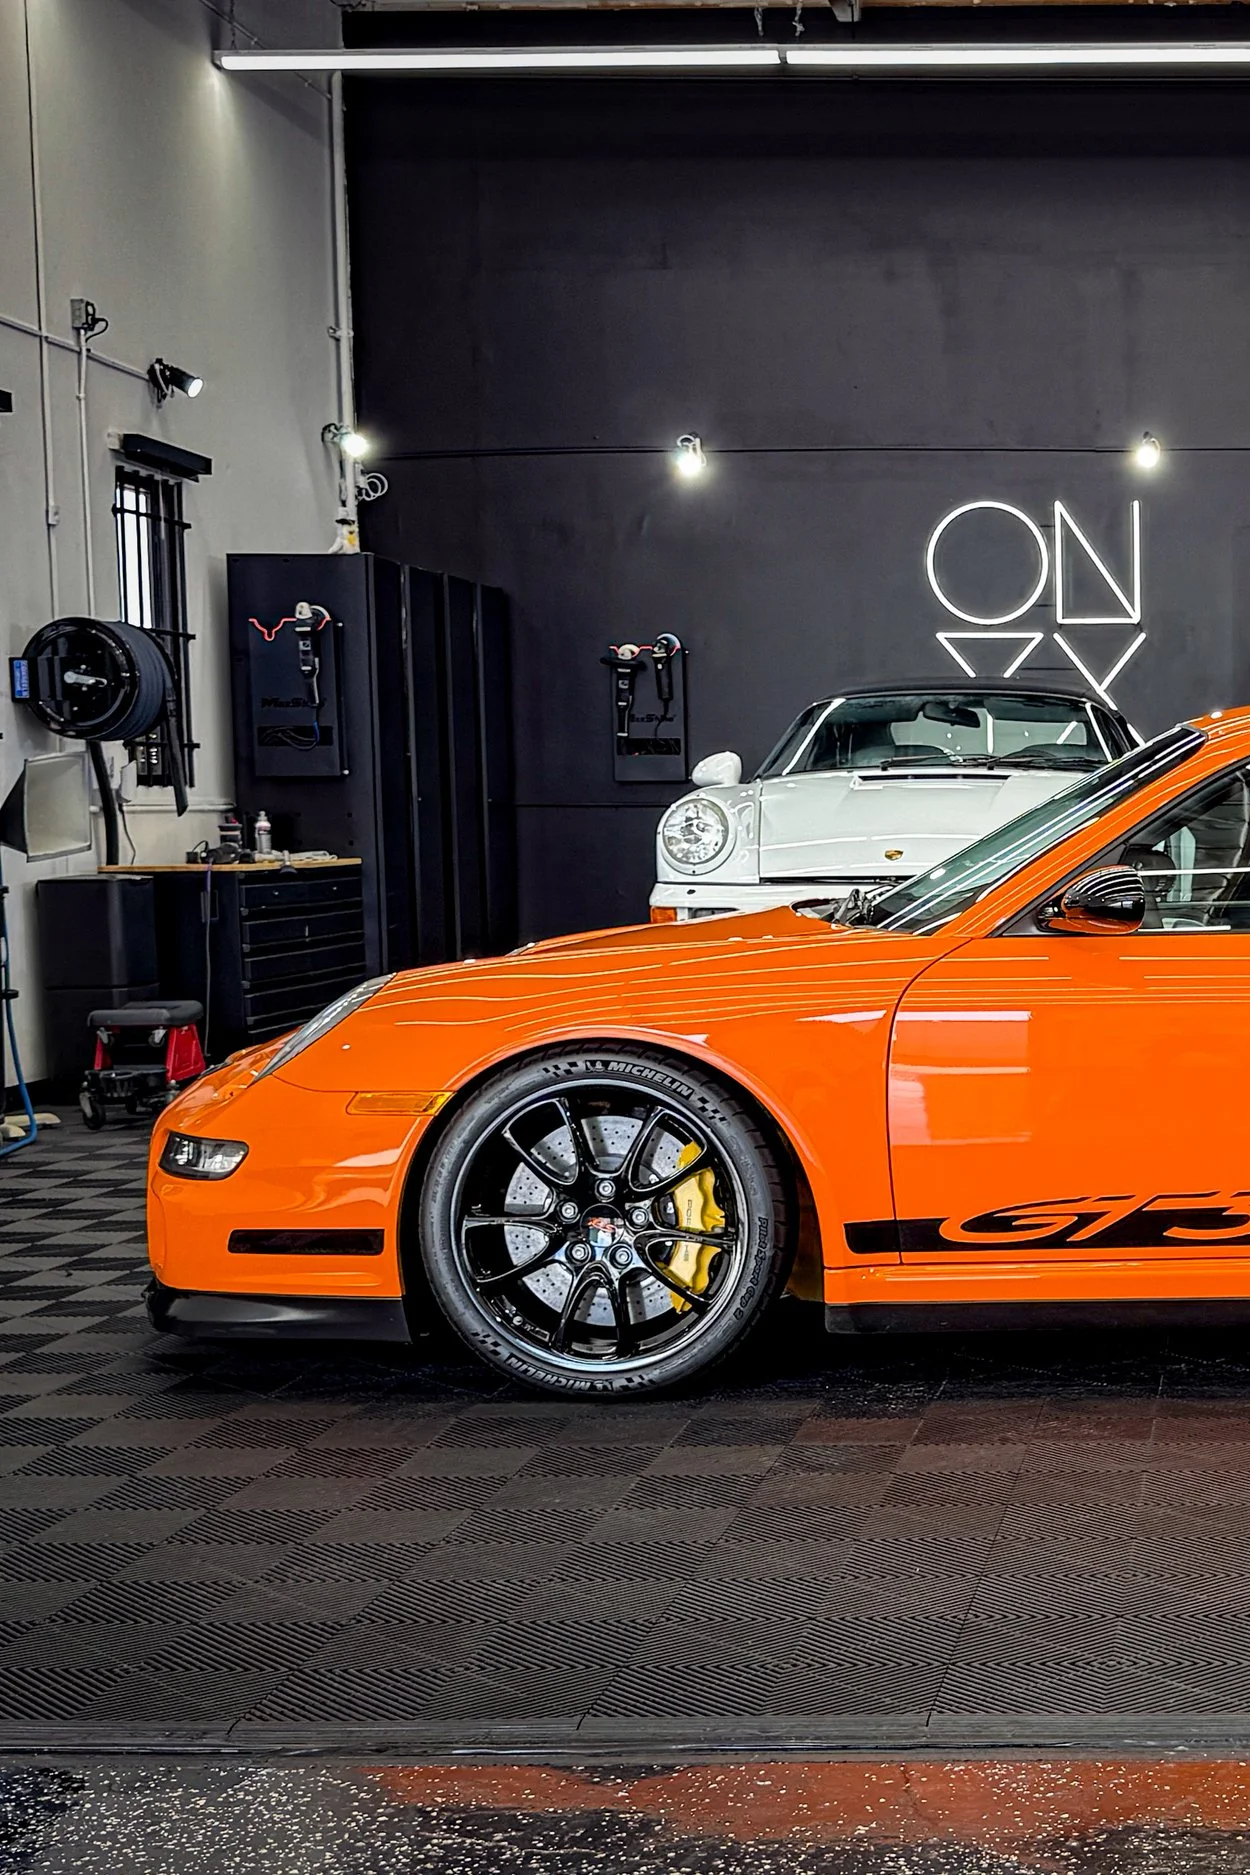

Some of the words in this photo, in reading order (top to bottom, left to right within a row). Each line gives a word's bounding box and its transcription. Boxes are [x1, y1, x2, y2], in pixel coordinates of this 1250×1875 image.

[926, 500, 1142, 625] ON
[607, 1061, 693, 1097] MICHELIN
[758, 1217, 769, 1249] Pilot
[749, 1249, 767, 1286] Sport
[733, 1308, 744, 1320] 2
[740, 1286, 756, 1309] Cup
[506, 1356, 591, 1391] MICHELIN
